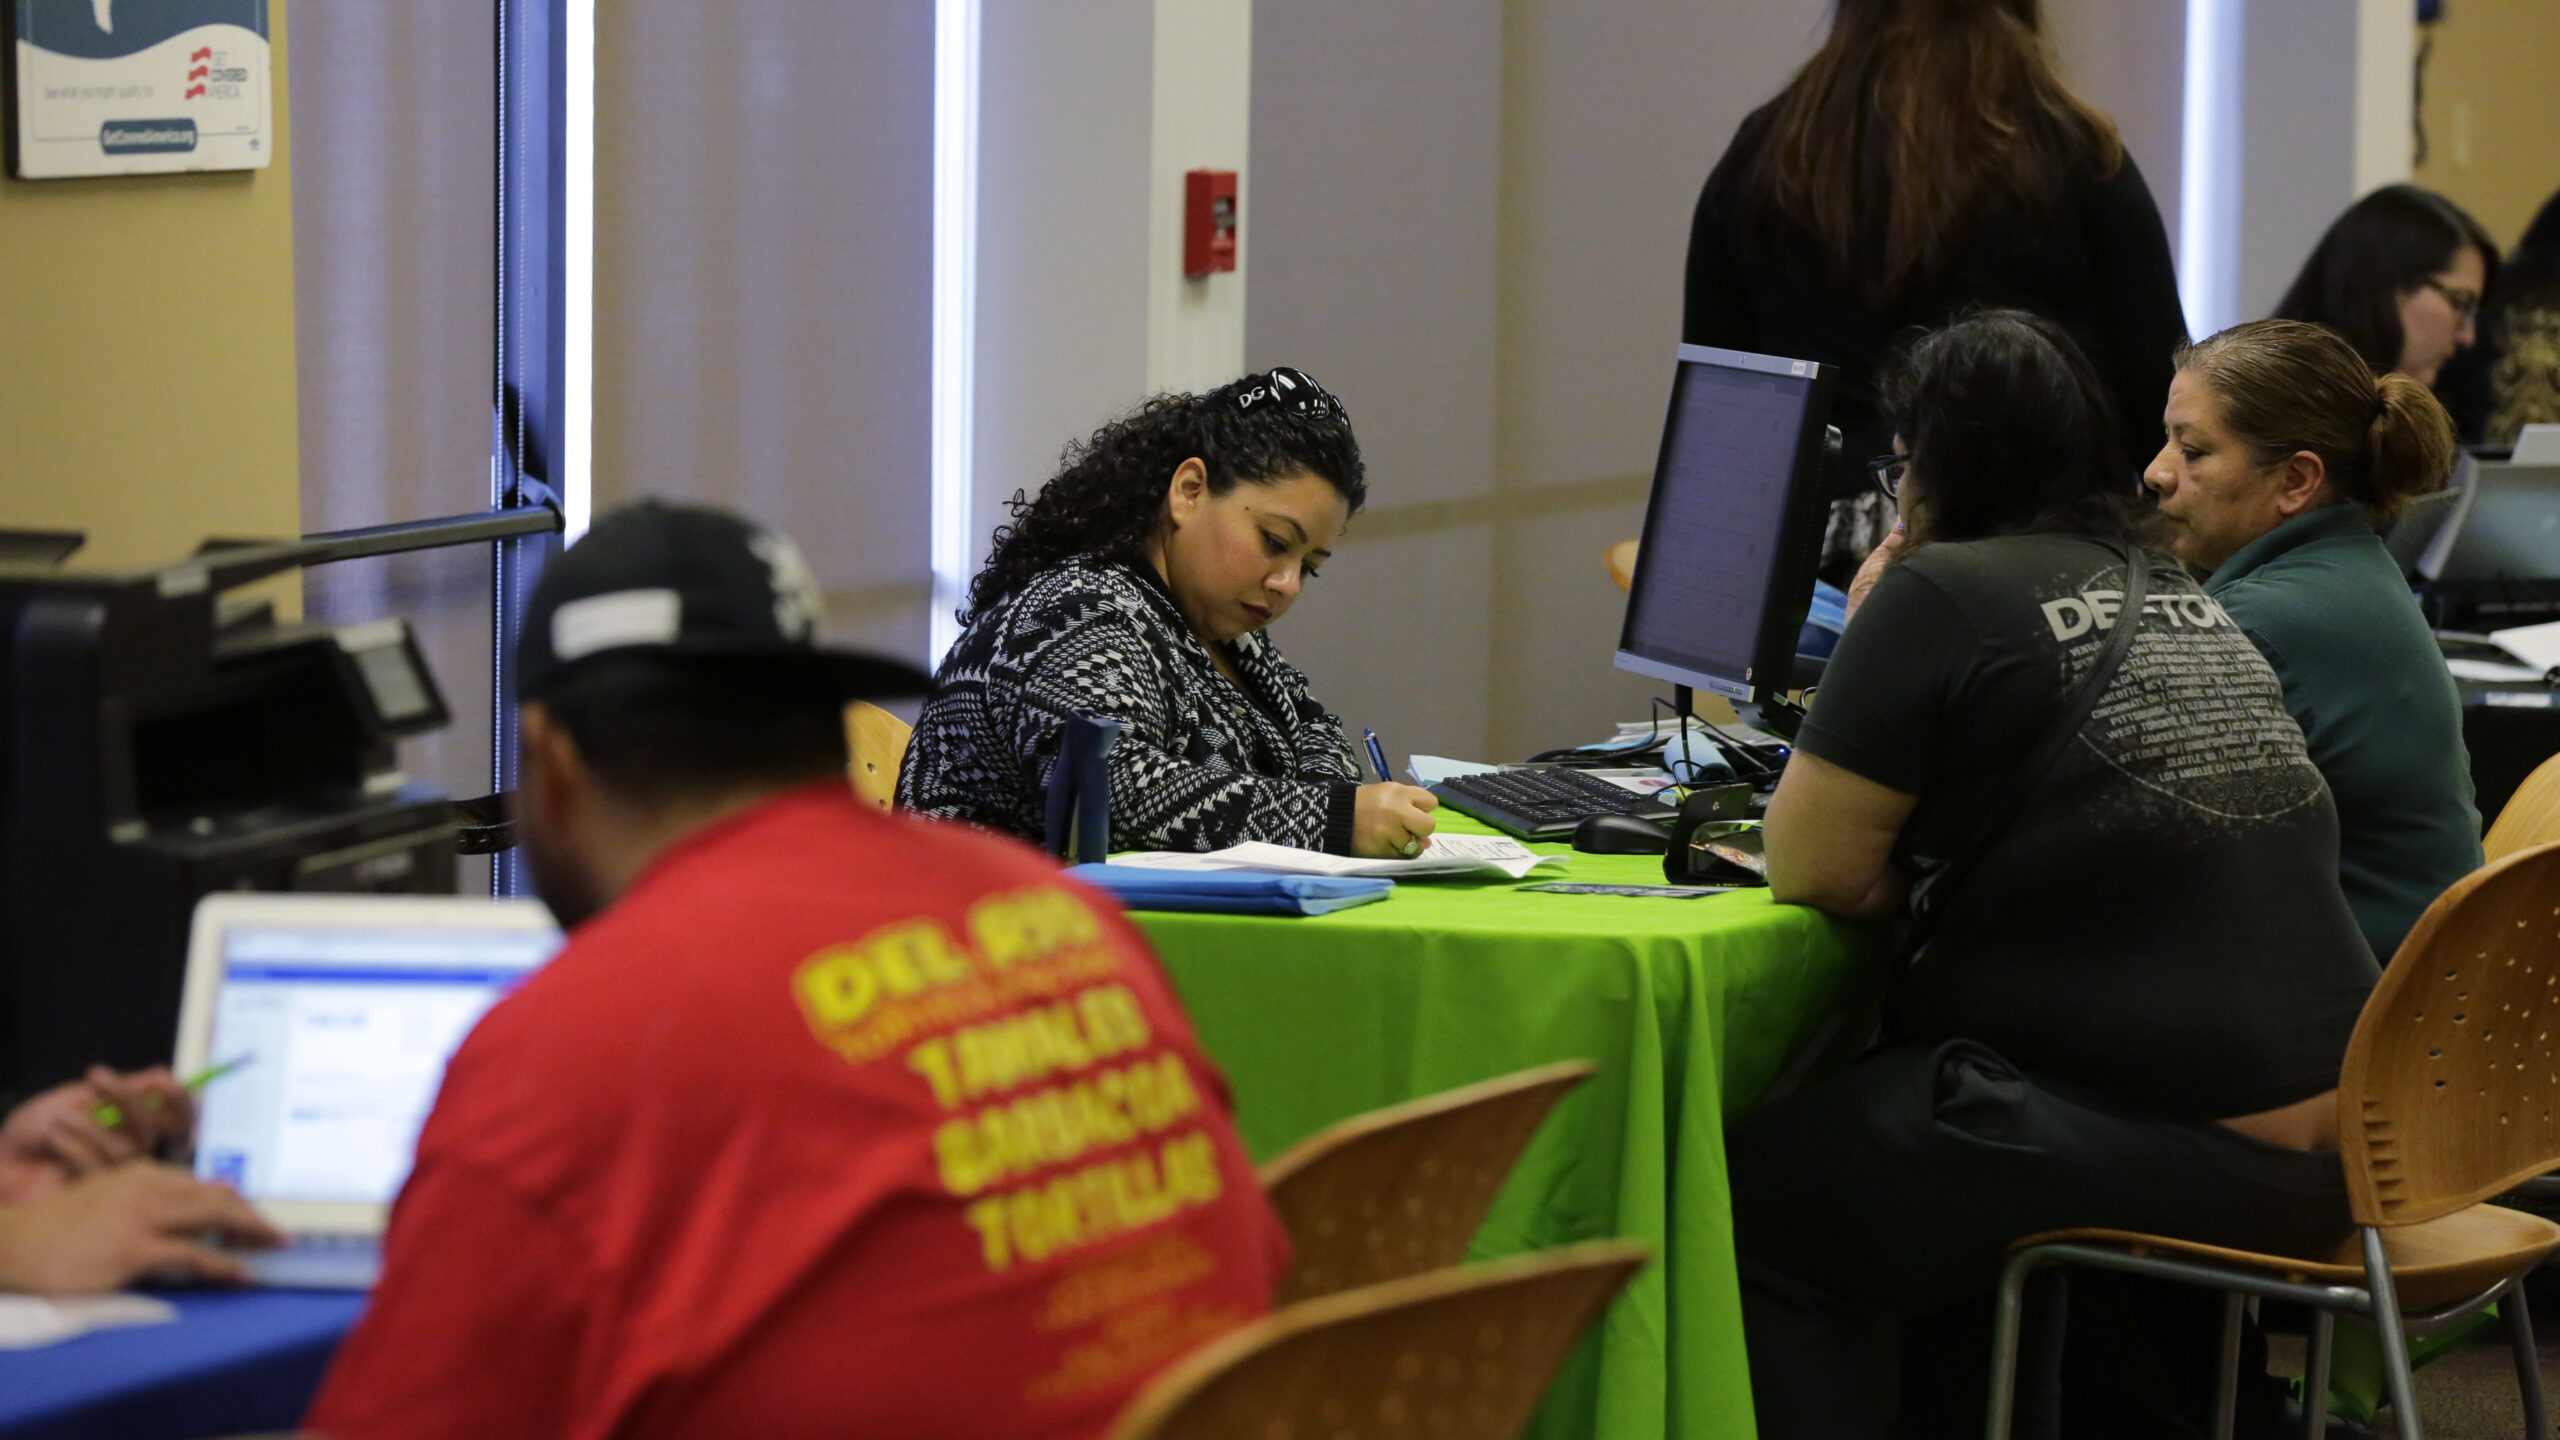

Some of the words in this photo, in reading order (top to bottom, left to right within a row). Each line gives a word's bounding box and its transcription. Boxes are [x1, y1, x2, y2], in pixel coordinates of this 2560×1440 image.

[1238, 386, 1266, 409] DG
[2106, 724, 2137, 741] WEST
[2261, 767, 2313, 796] 2010
[799, 919, 972, 1030] DEL
